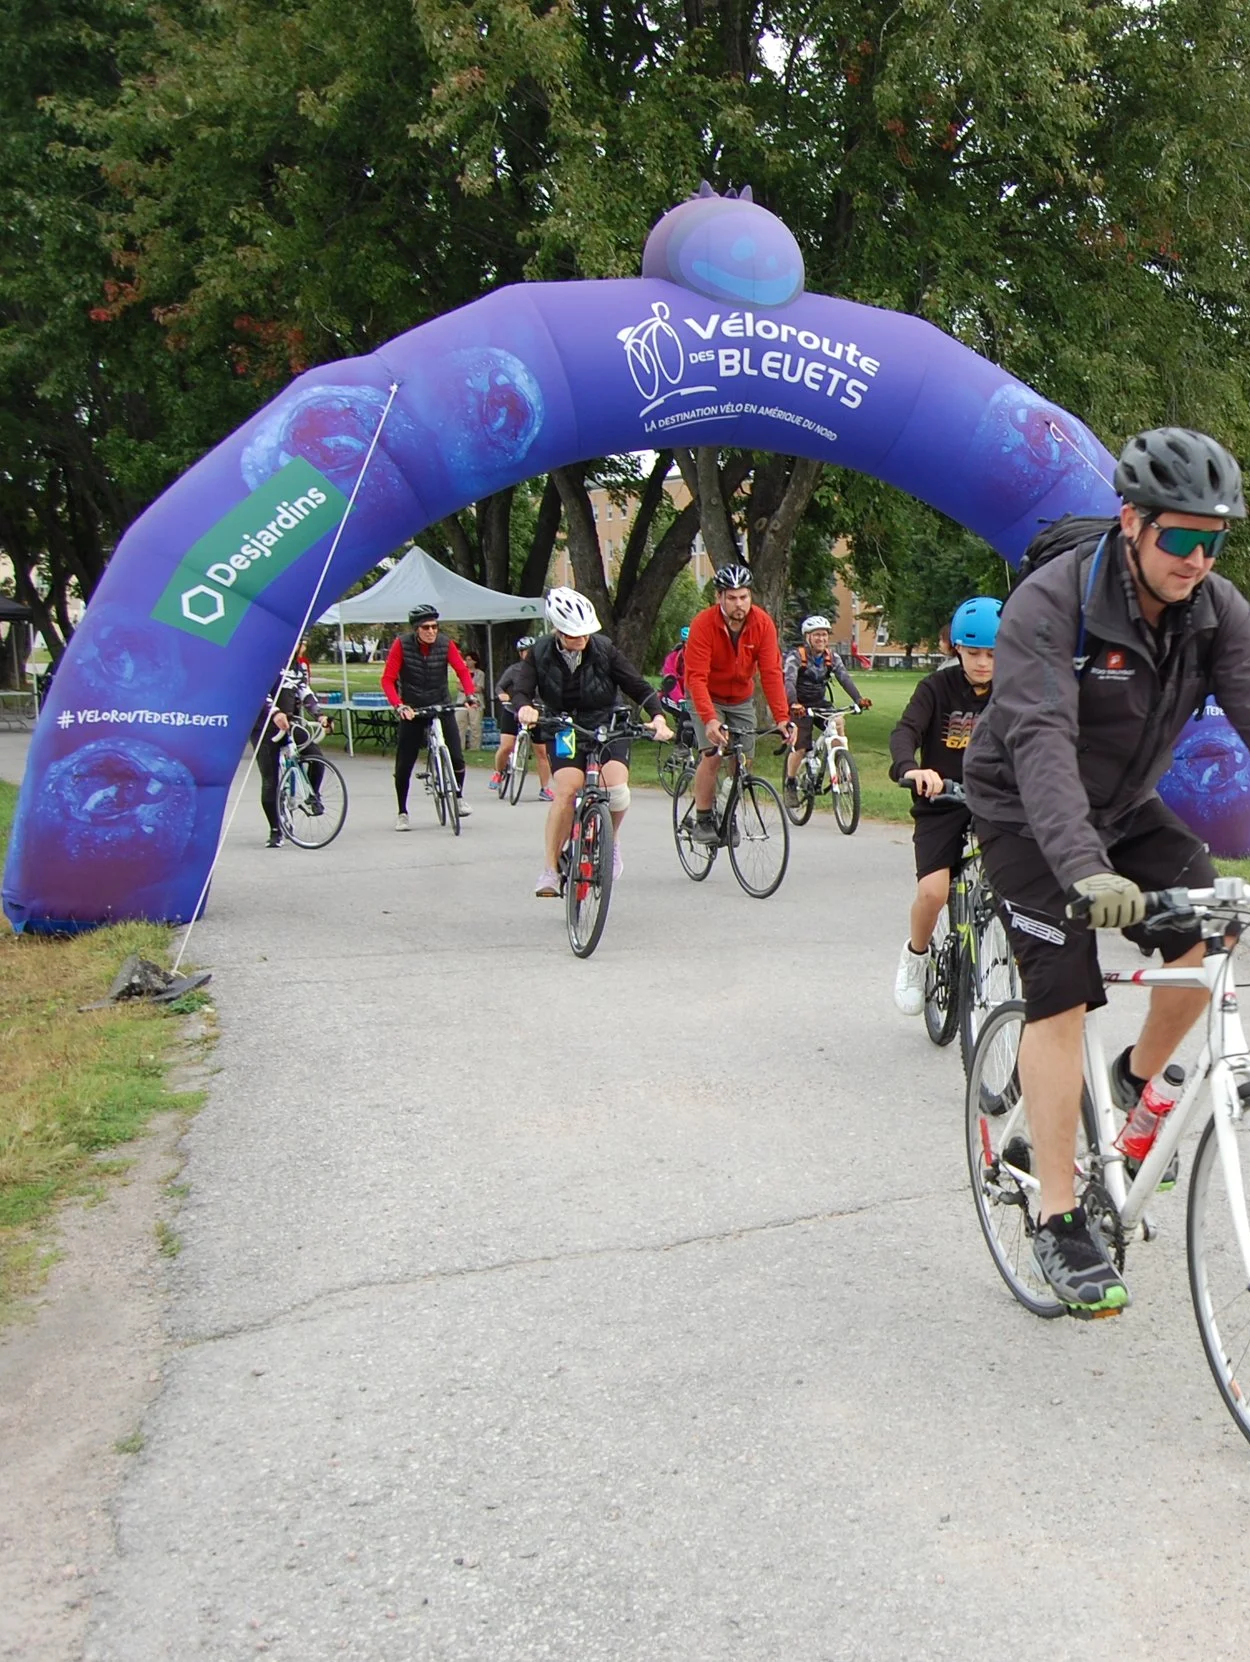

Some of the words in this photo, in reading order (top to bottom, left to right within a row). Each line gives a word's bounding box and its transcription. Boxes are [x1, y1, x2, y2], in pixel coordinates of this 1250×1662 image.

[683, 312, 881, 377] Véloroute
[689, 350, 715, 364] DES
[719, 348, 868, 409] BLEUETS
[644, 421, 657, 433] LA
[658, 405, 718, 427] DESTINATION
[719, 401, 743, 415] VÉLO
[744, 403, 757, 414] EN
[758, 404, 803, 425] AMÉRIQUE
[802, 418, 816, 431] DU
[815, 423, 838, 442] NORD
[205, 486, 327, 588] Desjardins
